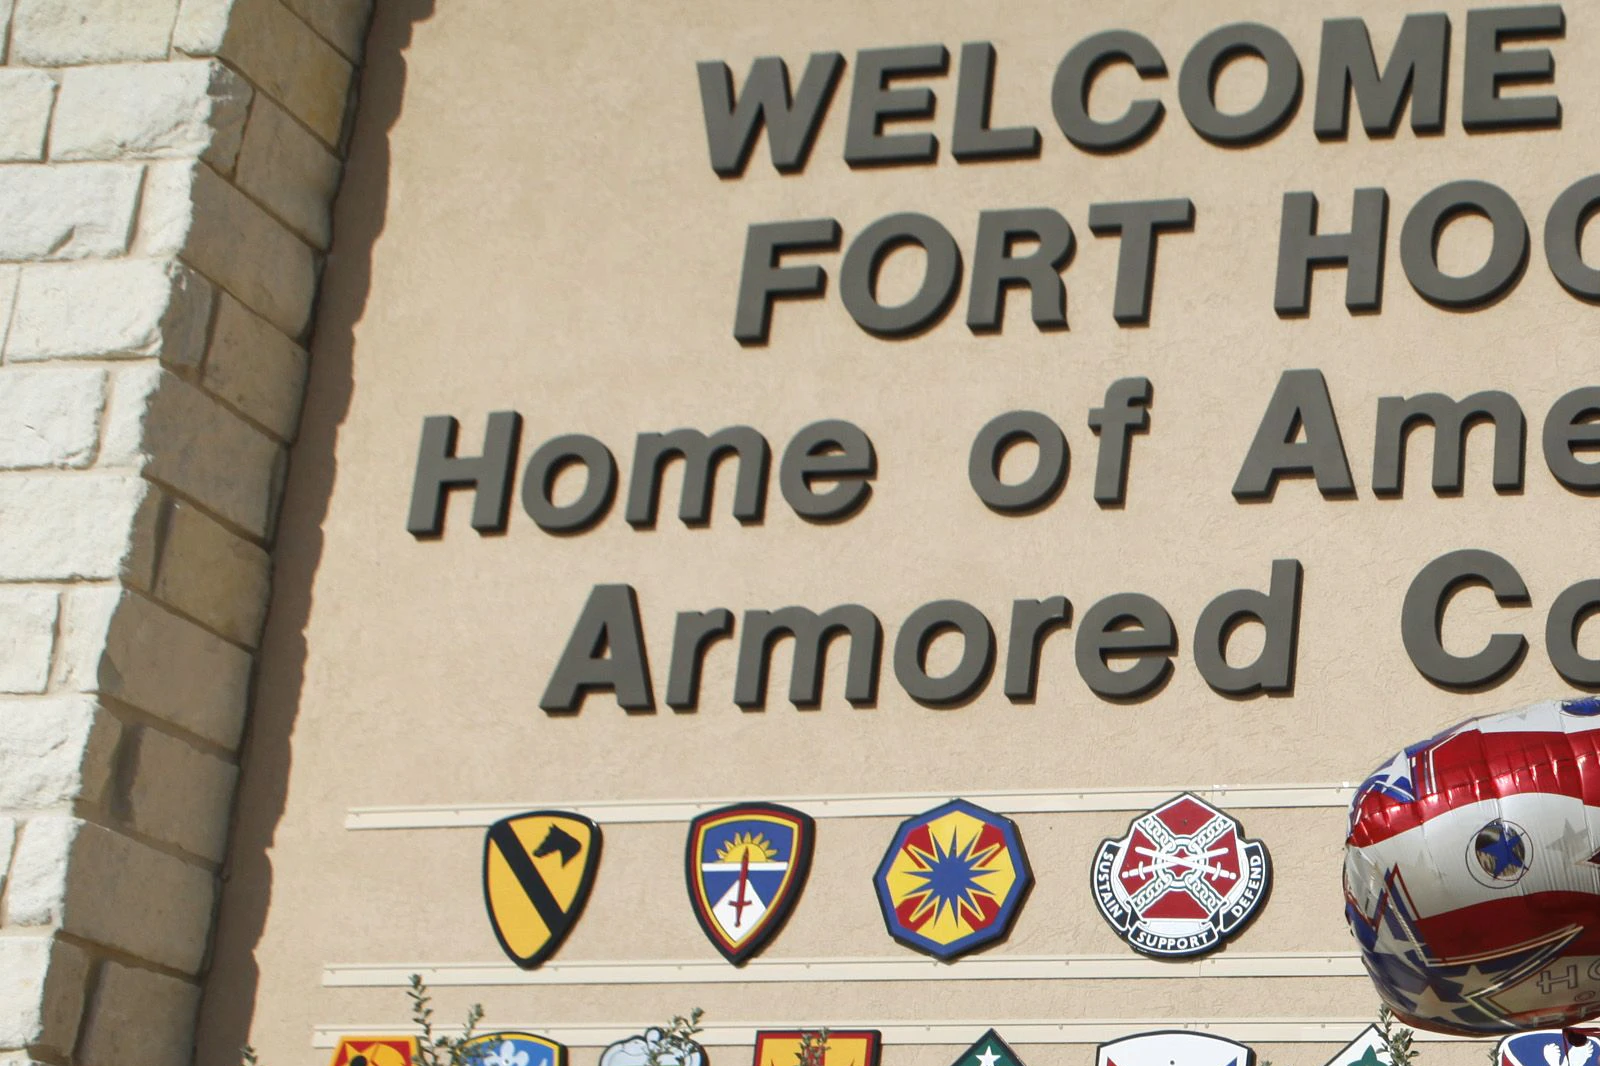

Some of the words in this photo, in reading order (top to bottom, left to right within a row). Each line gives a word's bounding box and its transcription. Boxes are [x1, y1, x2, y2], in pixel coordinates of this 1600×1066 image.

[696, 4, 1566, 179] WELCOME
[733, 198, 1195, 347] FORT
[406, 410, 877, 541] Home
[968, 377, 1152, 517] of
[539, 559, 1303, 715] Armored
[1098, 851, 1122, 918] SUSTAIN
[1137, 932, 1208, 950] SUPPORT
[1231, 855, 1262, 918] DEFEND
